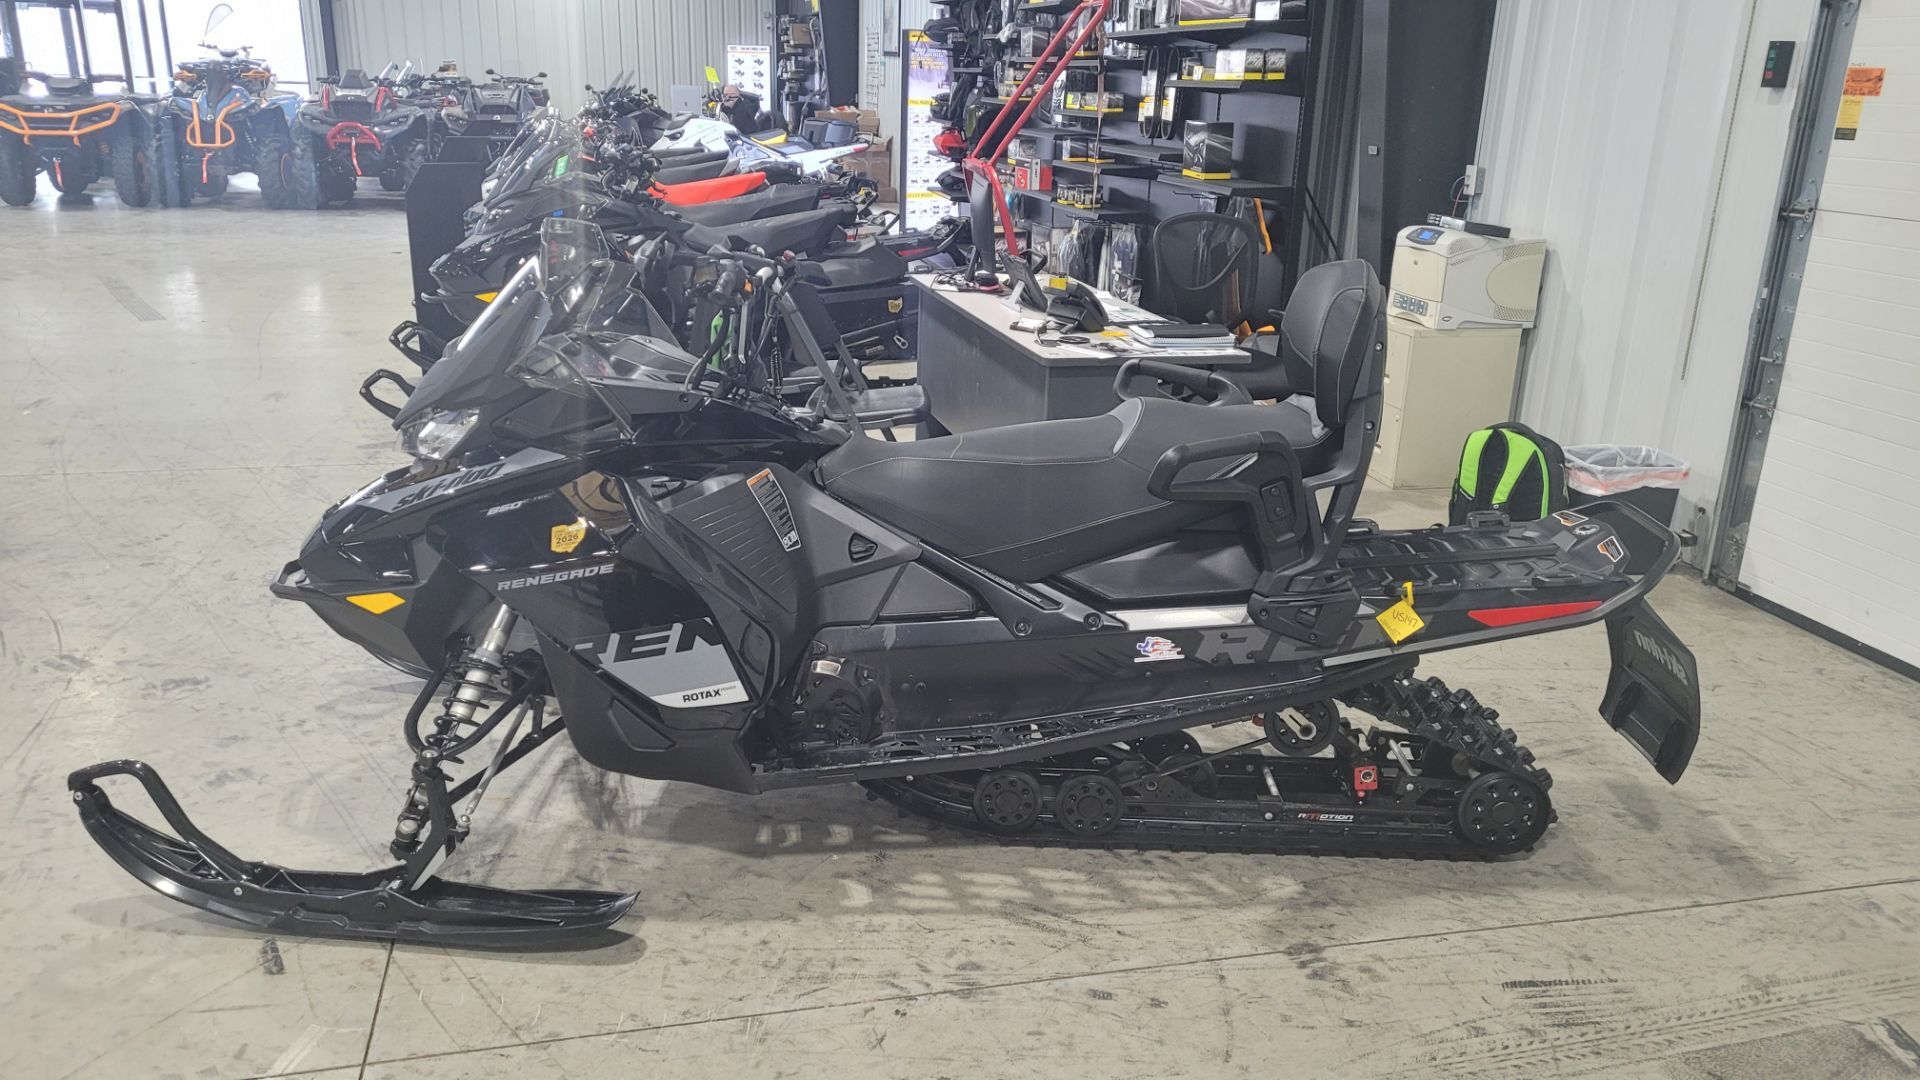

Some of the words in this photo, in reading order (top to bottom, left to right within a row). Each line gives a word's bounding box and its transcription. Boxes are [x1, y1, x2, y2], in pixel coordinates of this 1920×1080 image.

[556, 534, 579, 545] 2026
[497, 563, 615, 591] RENEGADE
[1392, 609, 1418, 628] US147
[682, 688, 721, 703] ROTAX
